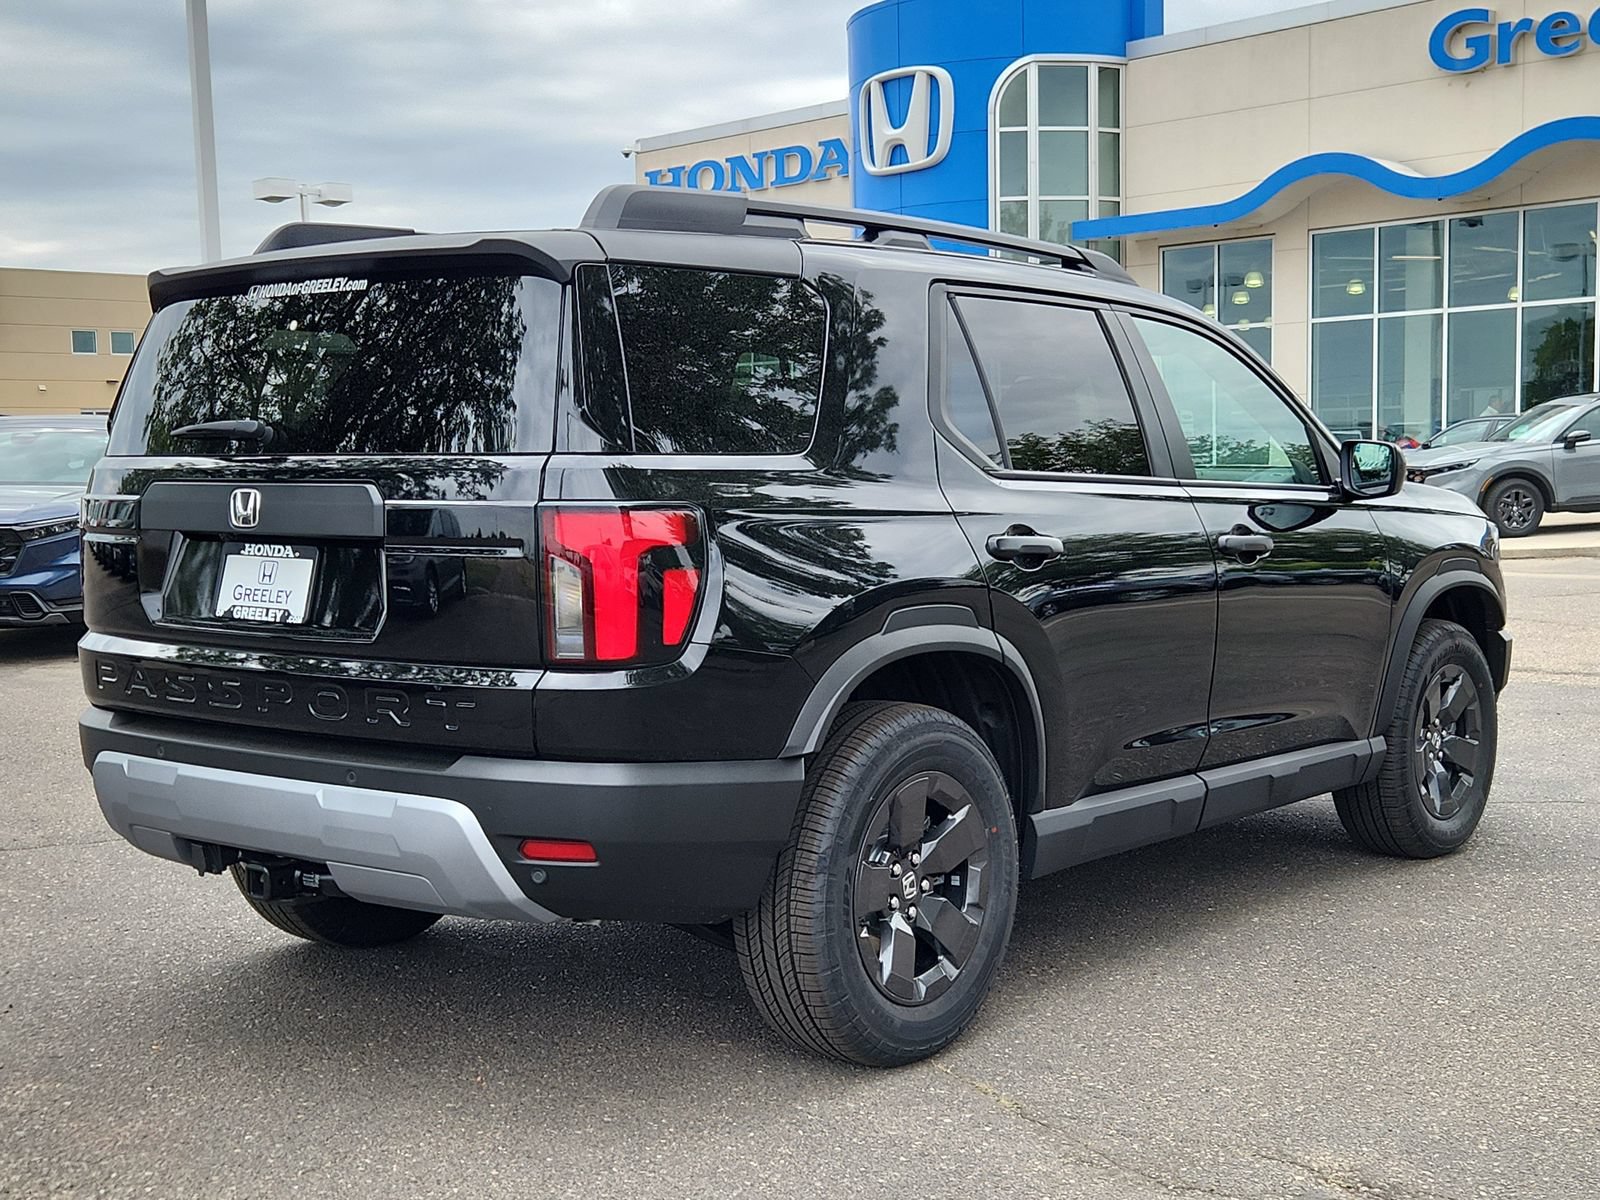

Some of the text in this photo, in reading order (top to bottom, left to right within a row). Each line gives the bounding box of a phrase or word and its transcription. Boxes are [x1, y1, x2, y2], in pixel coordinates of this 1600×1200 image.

[1428, 6, 1600, 73] Gre
[244, 543, 294, 558] HONDA
[233, 584, 292, 605] GREELEY
[233, 605, 284, 622] GREELEY
[96, 657, 477, 732] PASSPORT
